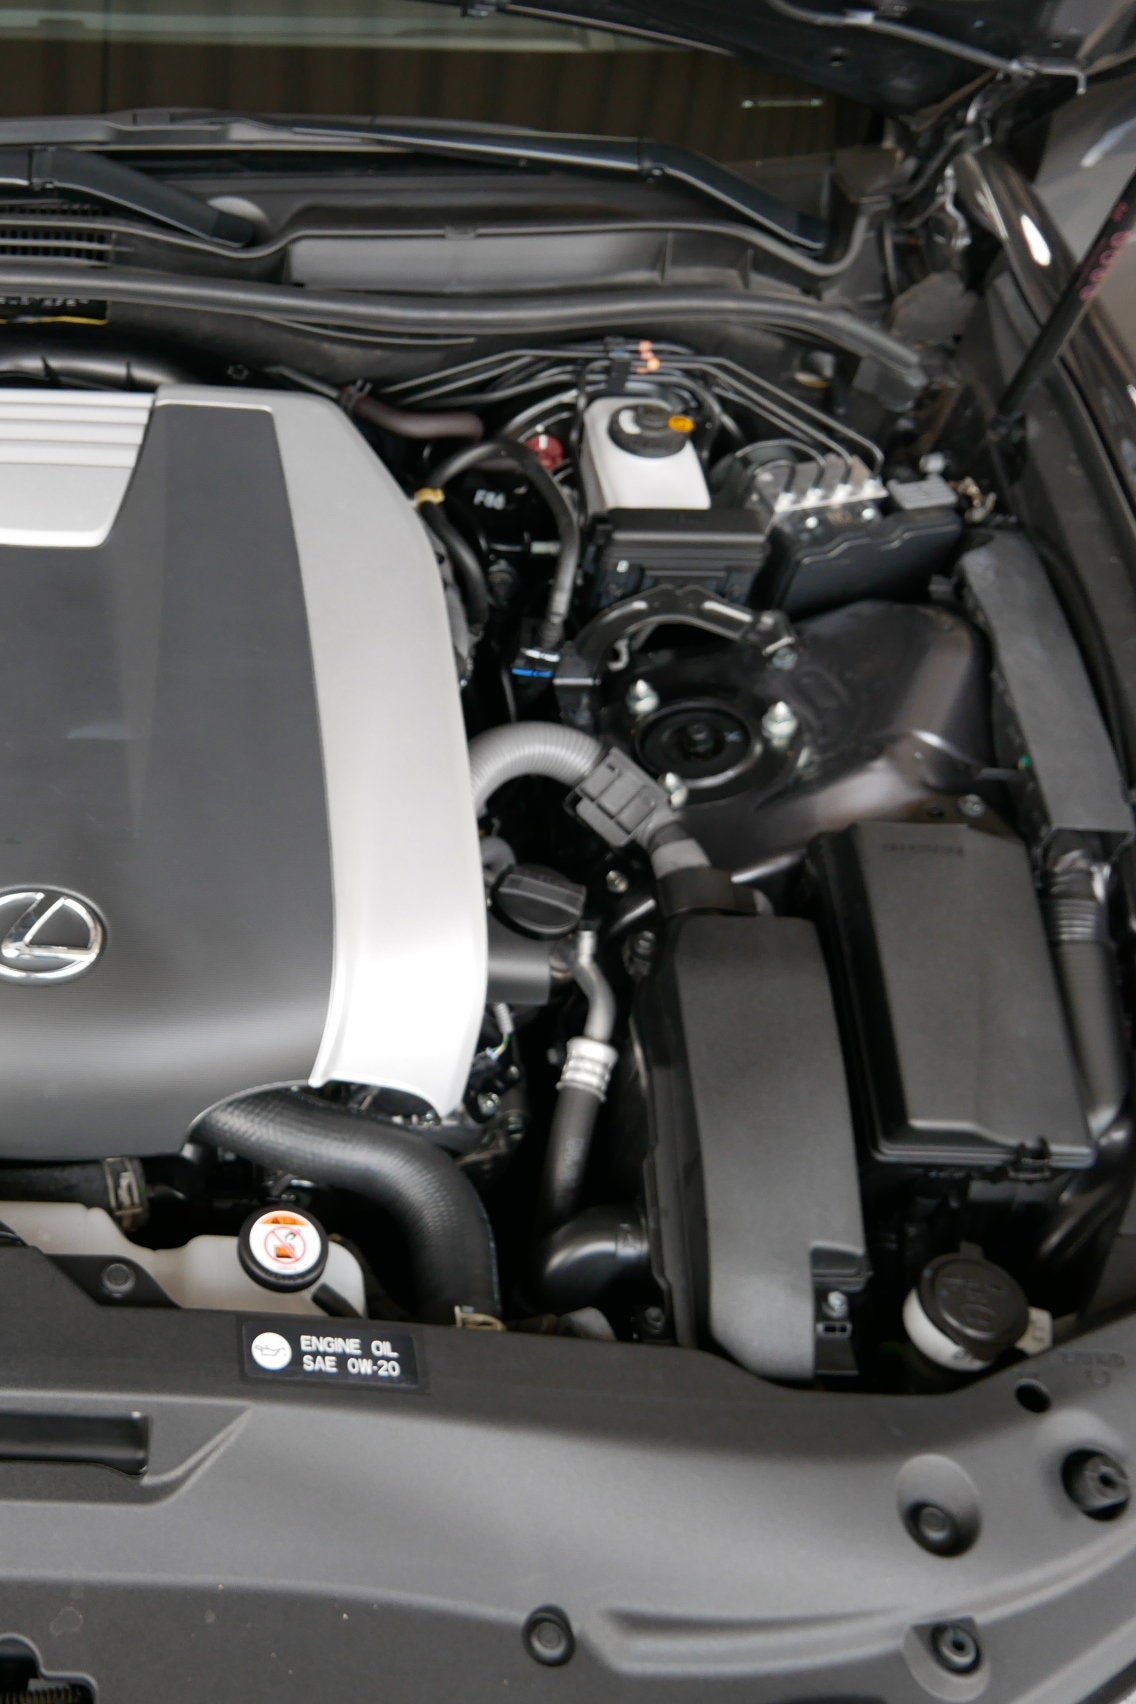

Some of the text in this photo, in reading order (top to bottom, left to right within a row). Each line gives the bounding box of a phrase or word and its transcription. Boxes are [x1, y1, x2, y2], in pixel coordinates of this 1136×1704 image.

[300, 1335, 400, 1358] ENGINE OIL
[302, 1355, 401, 1378] SAE 0W-20
